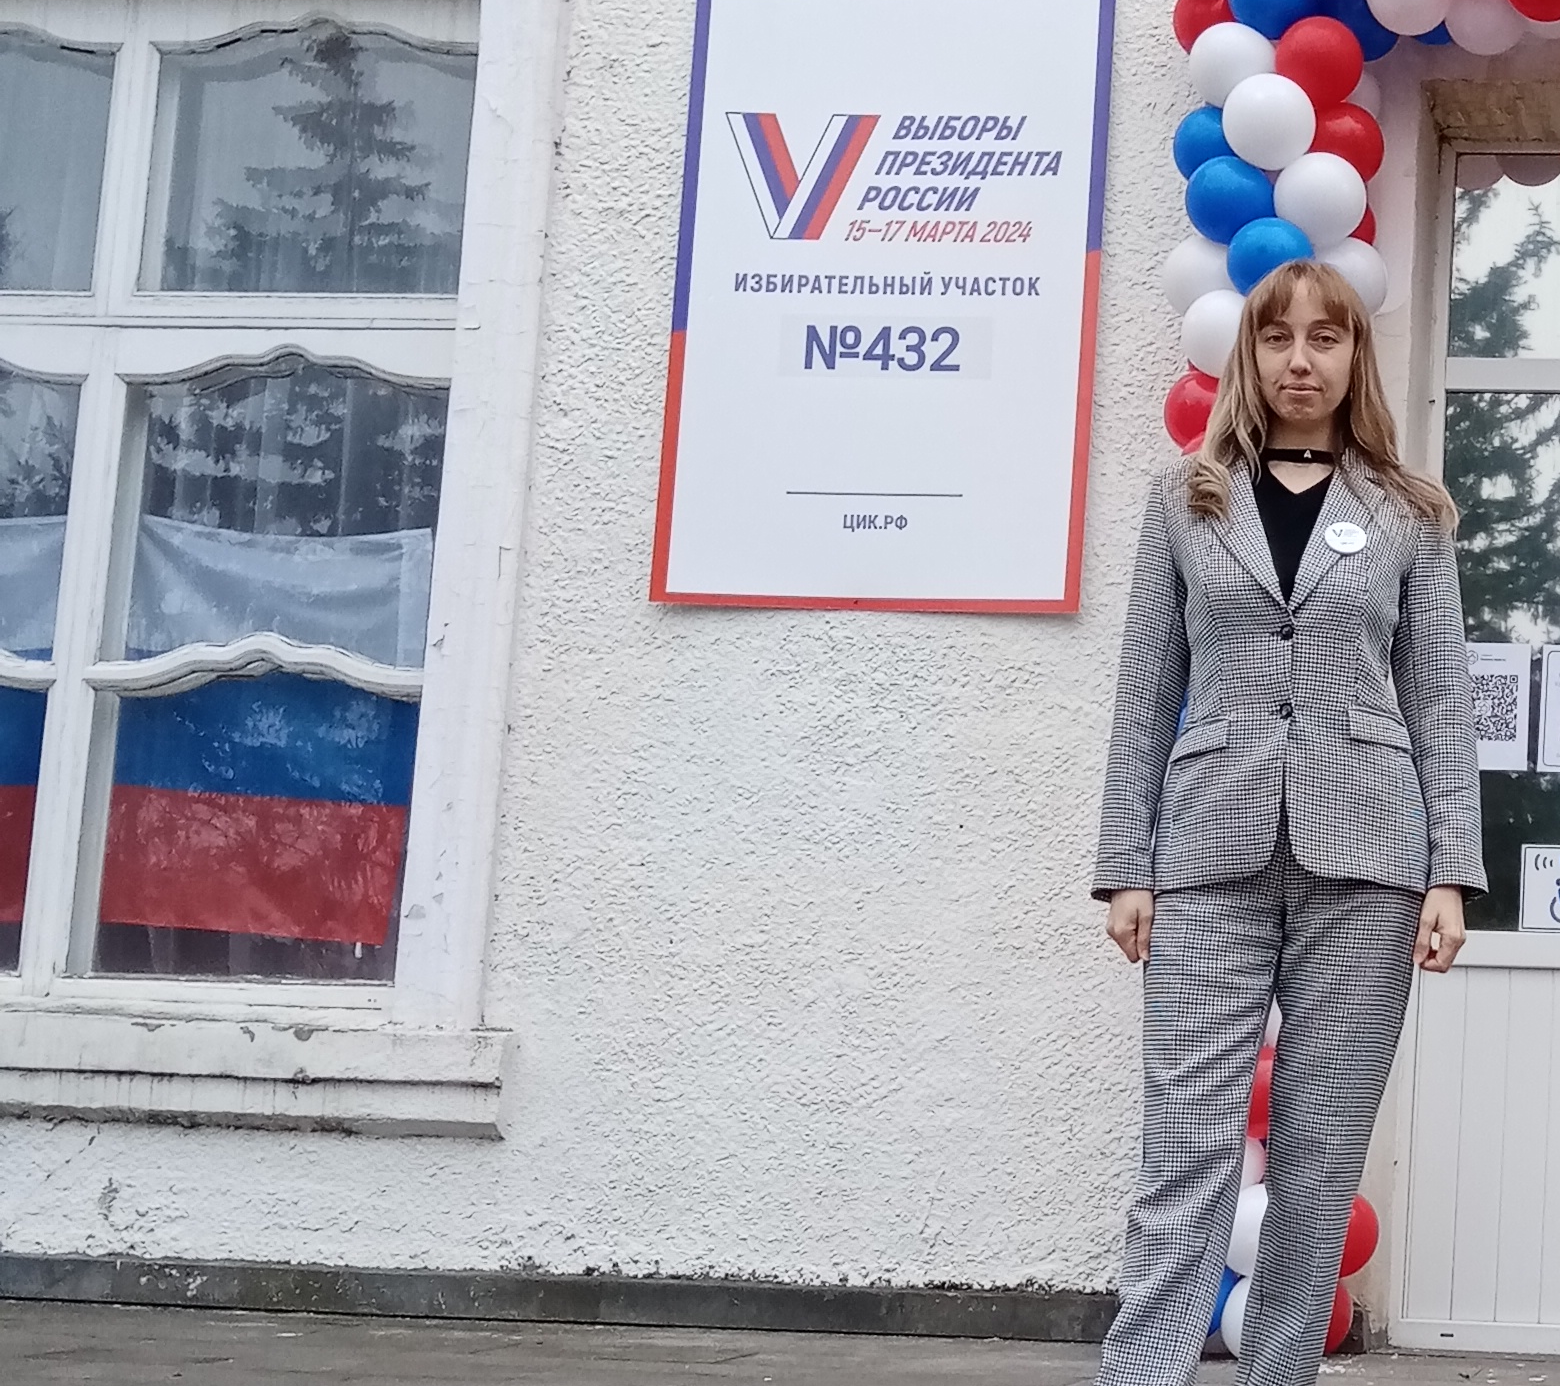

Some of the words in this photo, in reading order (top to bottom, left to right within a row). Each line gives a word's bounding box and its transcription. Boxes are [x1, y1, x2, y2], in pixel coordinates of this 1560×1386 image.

[892, 115, 1027, 141] ВЫБОРЫ
[874, 150, 1062, 180] ПРЕЗИДЕНТА
[856, 185, 980, 212] РОССИИ
[904, 220, 978, 243] МАРТА
[980, 220, 1033, 244] 2024
[734, 271, 933, 296] ИЗБИРАТЕЛЬНЫЙ
[940, 276, 1041, 297] УЧАСТОК
[804, 324, 961, 373] №432
[842, 513, 908, 533] ЦИК.РФ
